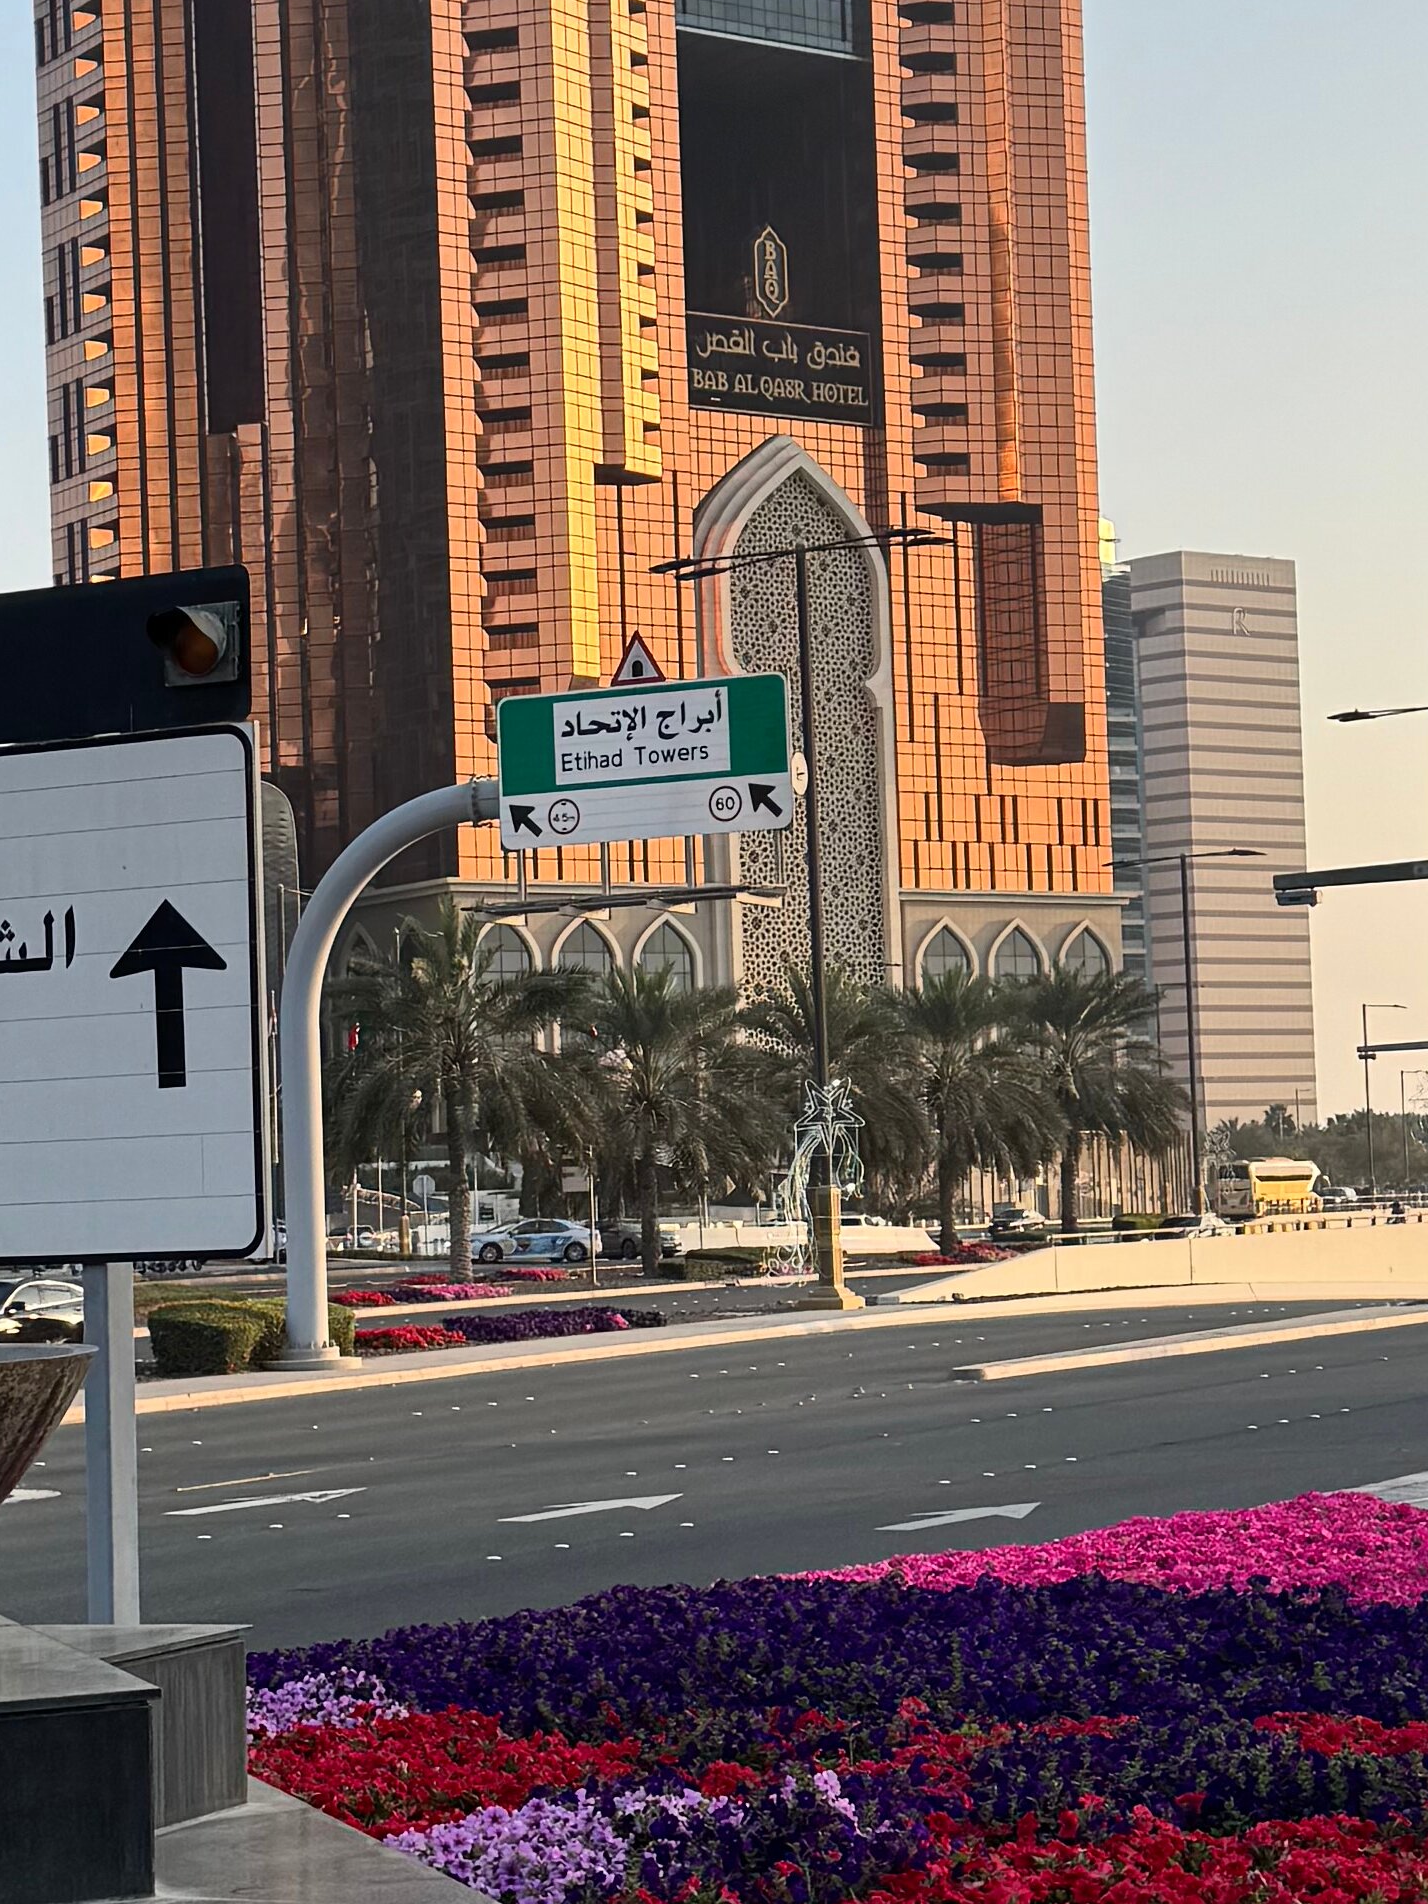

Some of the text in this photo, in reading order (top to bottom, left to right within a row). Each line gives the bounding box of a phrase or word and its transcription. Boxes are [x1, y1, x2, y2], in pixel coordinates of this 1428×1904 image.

[763, 239, 780, 304] BAQ
[696, 328, 861, 369] فندق باب القصر
[691, 368, 869, 406] BAB AL QASR HOTEL
[560, 689, 722, 741] أبراج الإتحاد
[561, 745, 709, 772] Etihad Towers
[716, 796, 736, 811] 60
